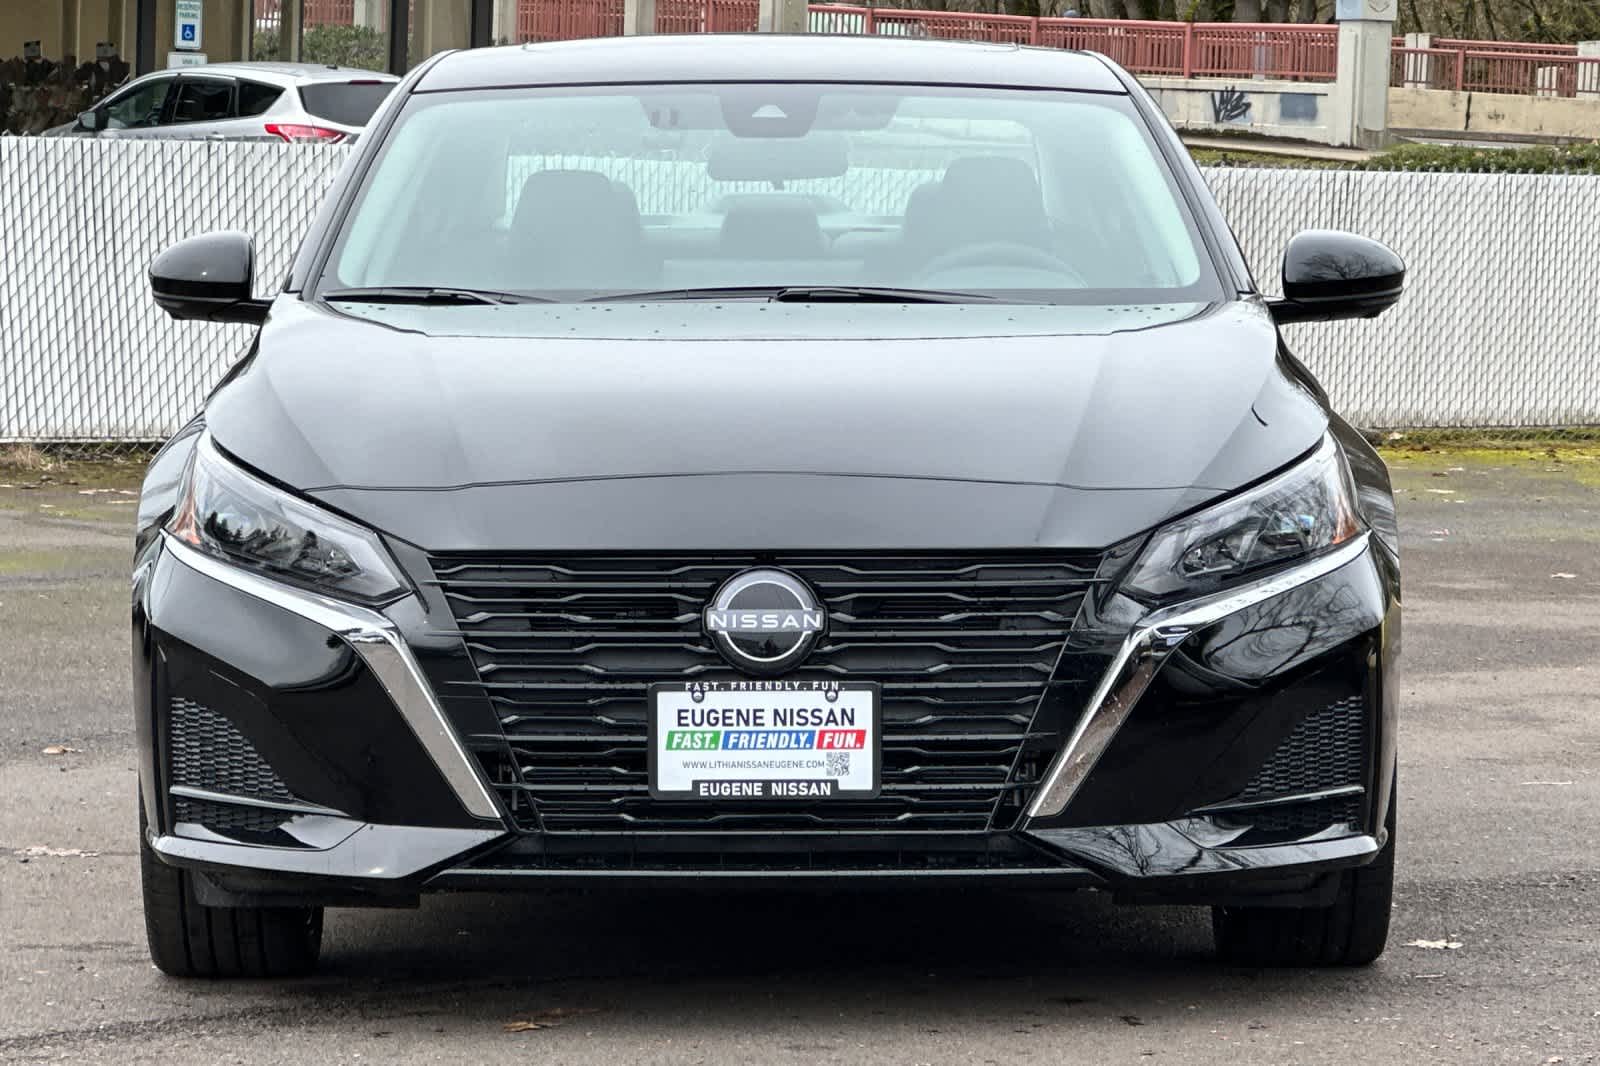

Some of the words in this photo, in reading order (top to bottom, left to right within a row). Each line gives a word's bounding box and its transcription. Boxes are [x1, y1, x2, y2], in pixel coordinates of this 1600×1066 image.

[710, 613, 821, 629] NISSAN
[685, 681, 725, 691] FAST.
[730, 681, 807, 691] FRIENDLY.
[677, 708, 765, 727] EUGENE
[773, 708, 855, 727] NISSAN
[671, 731, 716, 749] FAST.
[727, 731, 811, 749] FRIENDLY.
[823, 731, 861, 748] FUN.
[682, 760, 825, 769] WWW.LITHIANISSANEUGENE.COM
[699, 782, 763, 796] EUGENE
[771, 782, 831, 796] NISSAN
